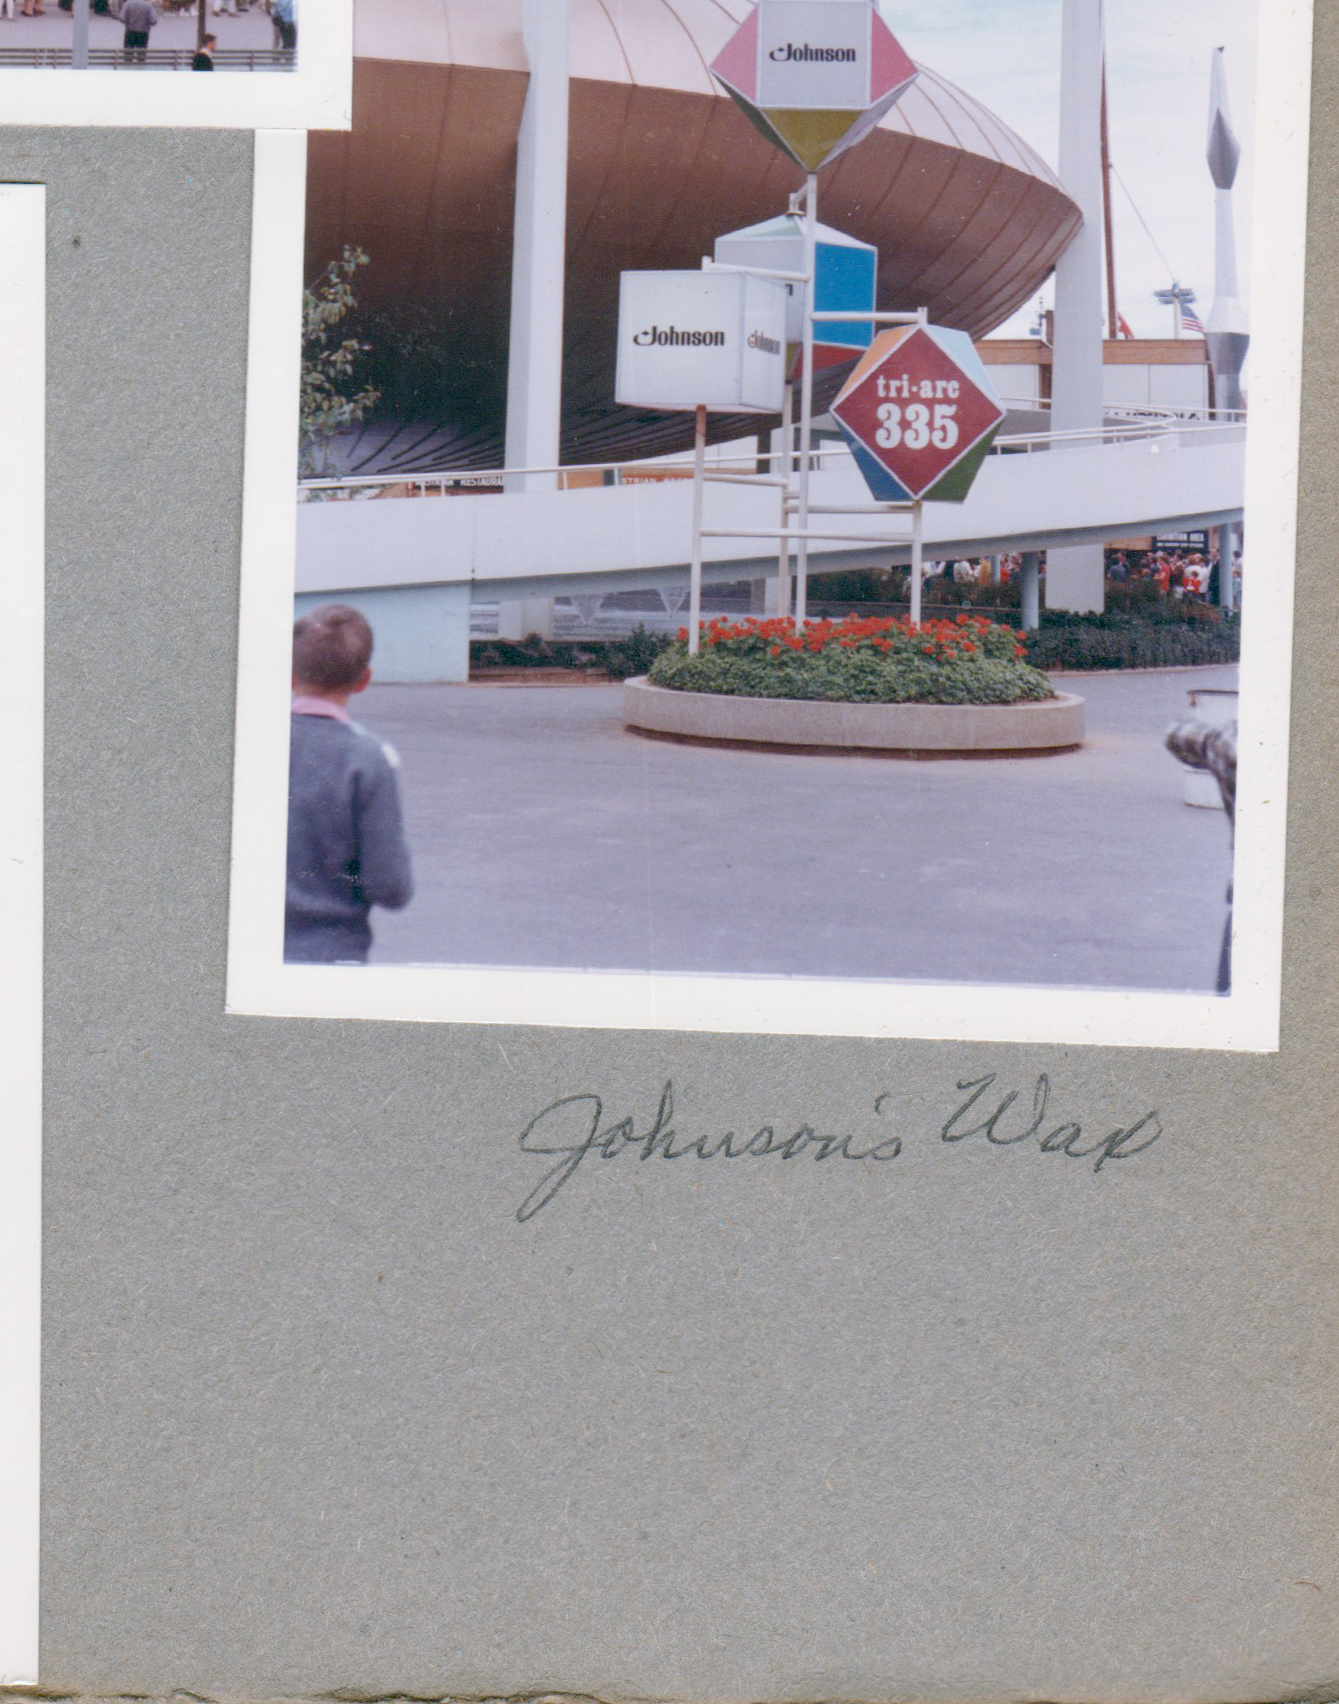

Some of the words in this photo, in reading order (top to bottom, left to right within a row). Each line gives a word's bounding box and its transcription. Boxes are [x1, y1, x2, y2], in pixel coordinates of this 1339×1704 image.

[769, 43, 856, 63] Johnson
[633, 326, 725, 347] Johnson
[875, 374, 960, 399] tri-arc
[875, 402, 959, 450] 335
[518, 1079, 902, 1223] Johnson's
[941, 1073, 1162, 1172] Wax
